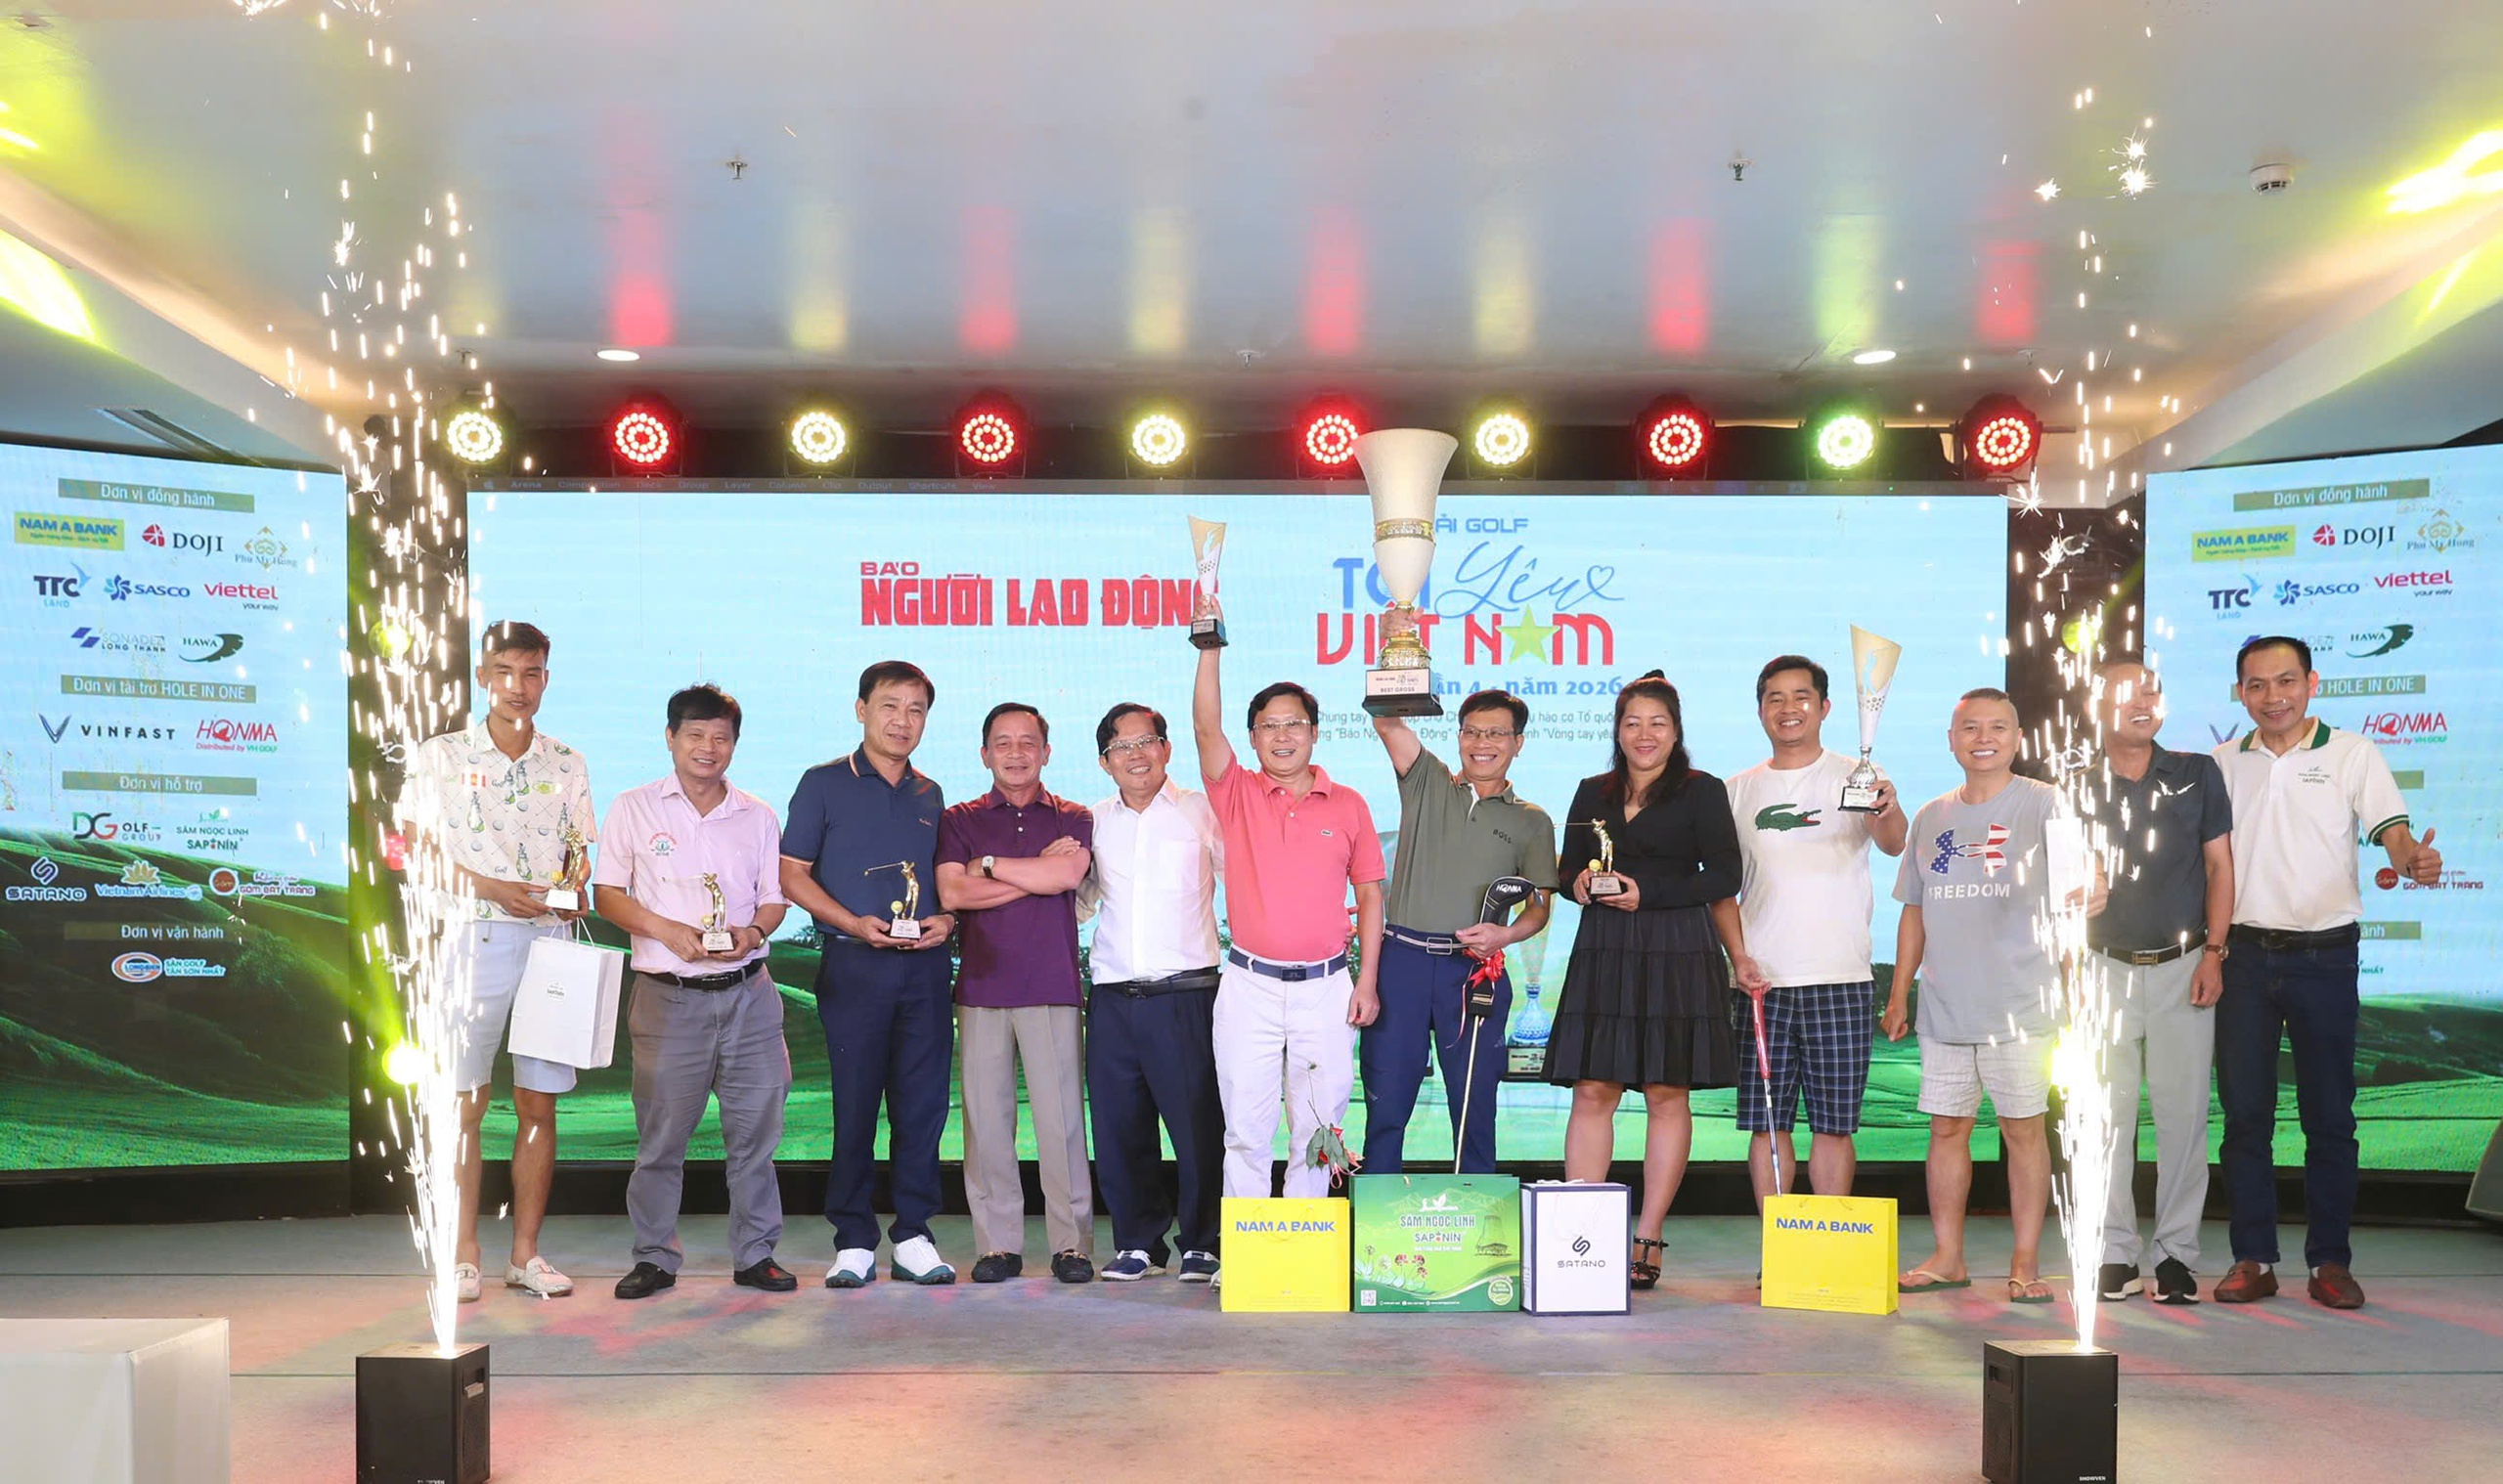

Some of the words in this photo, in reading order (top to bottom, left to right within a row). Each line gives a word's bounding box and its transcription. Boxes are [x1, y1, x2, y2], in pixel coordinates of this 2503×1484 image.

[101, 484, 128, 500] Đơn
[131, 488, 143, 502] vị
[148, 487, 180, 505] đồng
[183, 491, 215, 506] hành
[2273, 492, 2300, 506] Đơn
[2304, 491, 2315, 503] vị
[2318, 487, 2351, 503] đồng
[2354, 484, 2388, 500] hành
[20, 517, 58, 531] NAM
[61, 520, 71, 533] A
[73, 521, 118, 536] BANK
[1435, 514, 1457, 533] ẢI
[1466, 518, 1529, 533] GOLF
[172, 532, 224, 557] DOJI
[2196, 536, 2232, 548] NAM
[2234, 535, 2245, 546] A
[2247, 532, 2289, 545] BANK
[2343, 526, 2395, 549] DOJI
[860, 561, 919, 576] BÁO
[33, 575, 80, 597] TTC
[1434, 541, 1625, 618] Yêu
[2374, 569, 2453, 589] viettel
[134, 584, 191, 597] SASCO
[203, 582, 279, 600] viettel
[2303, 583, 2359, 596] SASCO
[44, 599, 70, 608] LAND
[860, 573, 993, 626] NGƯỜI
[1006, 579, 1089, 626] LAO
[2208, 589, 2252, 609] TTC
[2217, 611, 2242, 620] LAND
[1317, 601, 1440, 665] VIT
[2350, 633, 2387, 642] HAWA
[182, 637, 218, 648] HAWA
[73, 677, 101, 691] Đơn
[105, 679, 116, 694] vị
[119, 679, 136, 694] tài
[161, 682, 197, 697] HOLE
[200, 684, 215, 699] IN
[219, 685, 245, 699] ONE
[1506, 677, 1559, 695] năm
[1565, 676, 1623, 695] 2026
[2327, 678, 2363, 694] HOLE
[2367, 678, 2383, 693] IN
[2386, 677, 2415, 691] ONE
[1350, 713, 1368, 724] tay
[1594, 711, 1615, 724] quố
[2361, 712, 2447, 736] HONMA
[80, 724, 176, 740] VINFAST
[196, 719, 278, 742] HONMA
[119, 775, 147, 790] Đơn
[150, 776, 161, 792] vị
[122, 832, 161, 842] GROUP
[228, 827, 249, 836] LINH
[7, 887, 86, 900] SATANO
[95, 883, 146, 897] Vietnam
[147, 884, 186, 897] Airlines
[1496, 883, 1522, 894] HONMA
[1928, 883, 2011, 898] FREEDOM
[121, 925, 148, 938] Đơn
[152, 925, 162, 940] vị
[166, 925, 189, 940] vận
[193, 926, 224, 938] hành
[2360, 924, 2386, 938] ành
[1236, 1220, 1274, 1232] NAM
[1276, 1220, 1288, 1232] A
[1291, 1220, 1337, 1232] BANK
[1453, 1215, 1475, 1228] LINH
[1777, 1217, 1813, 1231] NAM
[1816, 1220, 1827, 1231] A
[1829, 1221, 1873, 1234] BANK
[1557, 1259, 1606, 1269] SATANO
